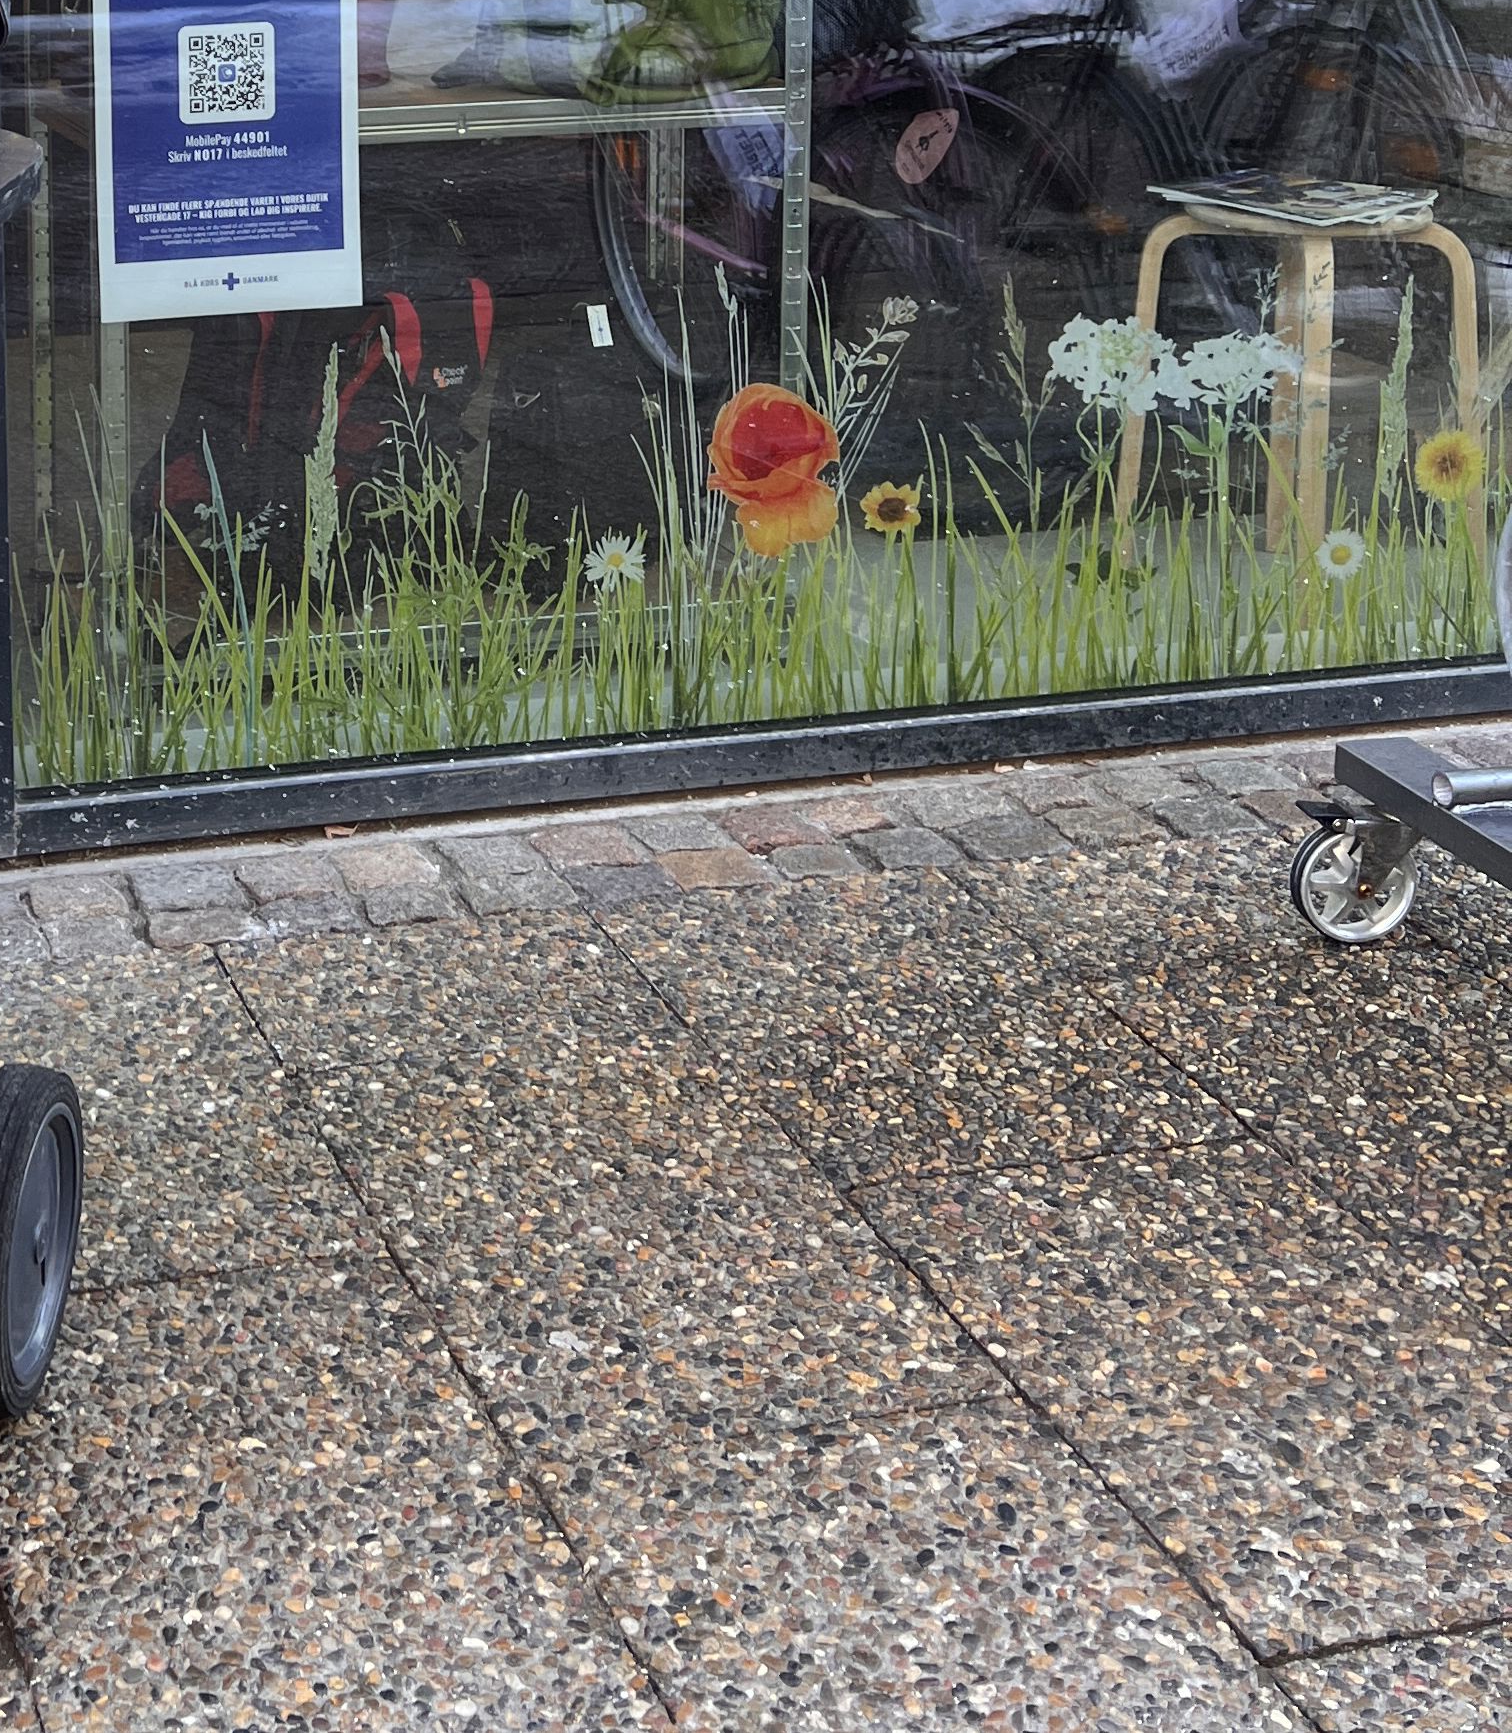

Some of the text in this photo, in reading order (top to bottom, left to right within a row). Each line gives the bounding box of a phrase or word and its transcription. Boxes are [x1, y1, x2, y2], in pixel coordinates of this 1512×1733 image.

[185, 131, 270, 148] MobilePay 44901
[168, 150, 192, 163] Skriv
[231, 145, 288, 160] beskedfeltet
